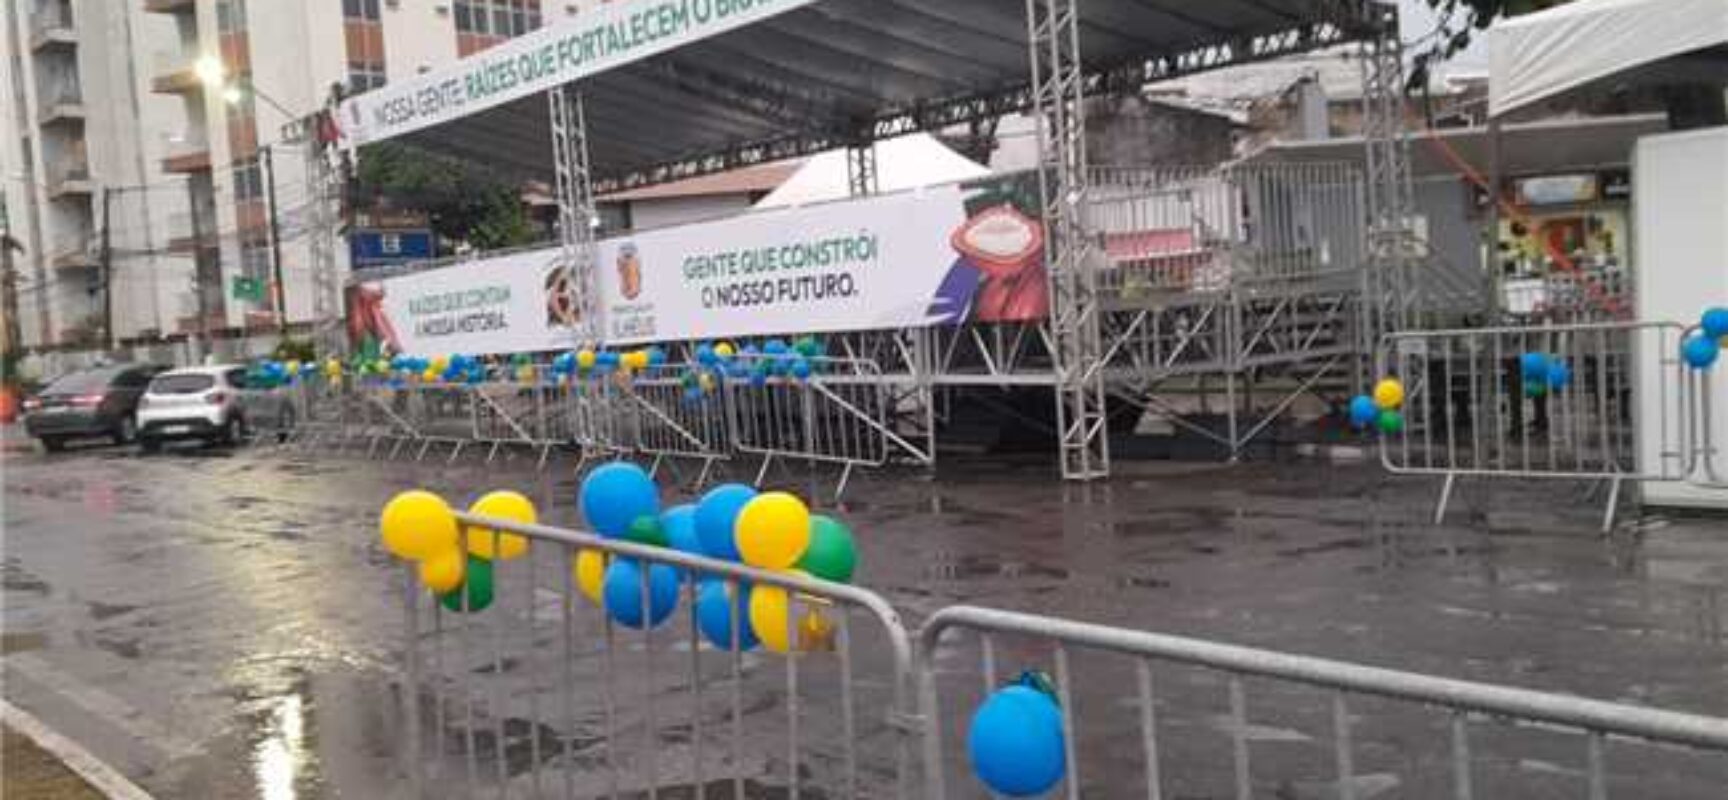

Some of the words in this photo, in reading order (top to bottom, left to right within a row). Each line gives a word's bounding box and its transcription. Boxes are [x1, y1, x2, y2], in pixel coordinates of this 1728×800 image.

[519, 45, 555, 82] QUE
[557, 3, 690, 68] FORTALECEM
[683, 251, 738, 280] GENTE
[741, 247, 778, 274] QUE
[702, 285, 713, 309] O
[717, 279, 775, 308] NOSSO
[778, 271, 858, 302] FUTURO.
